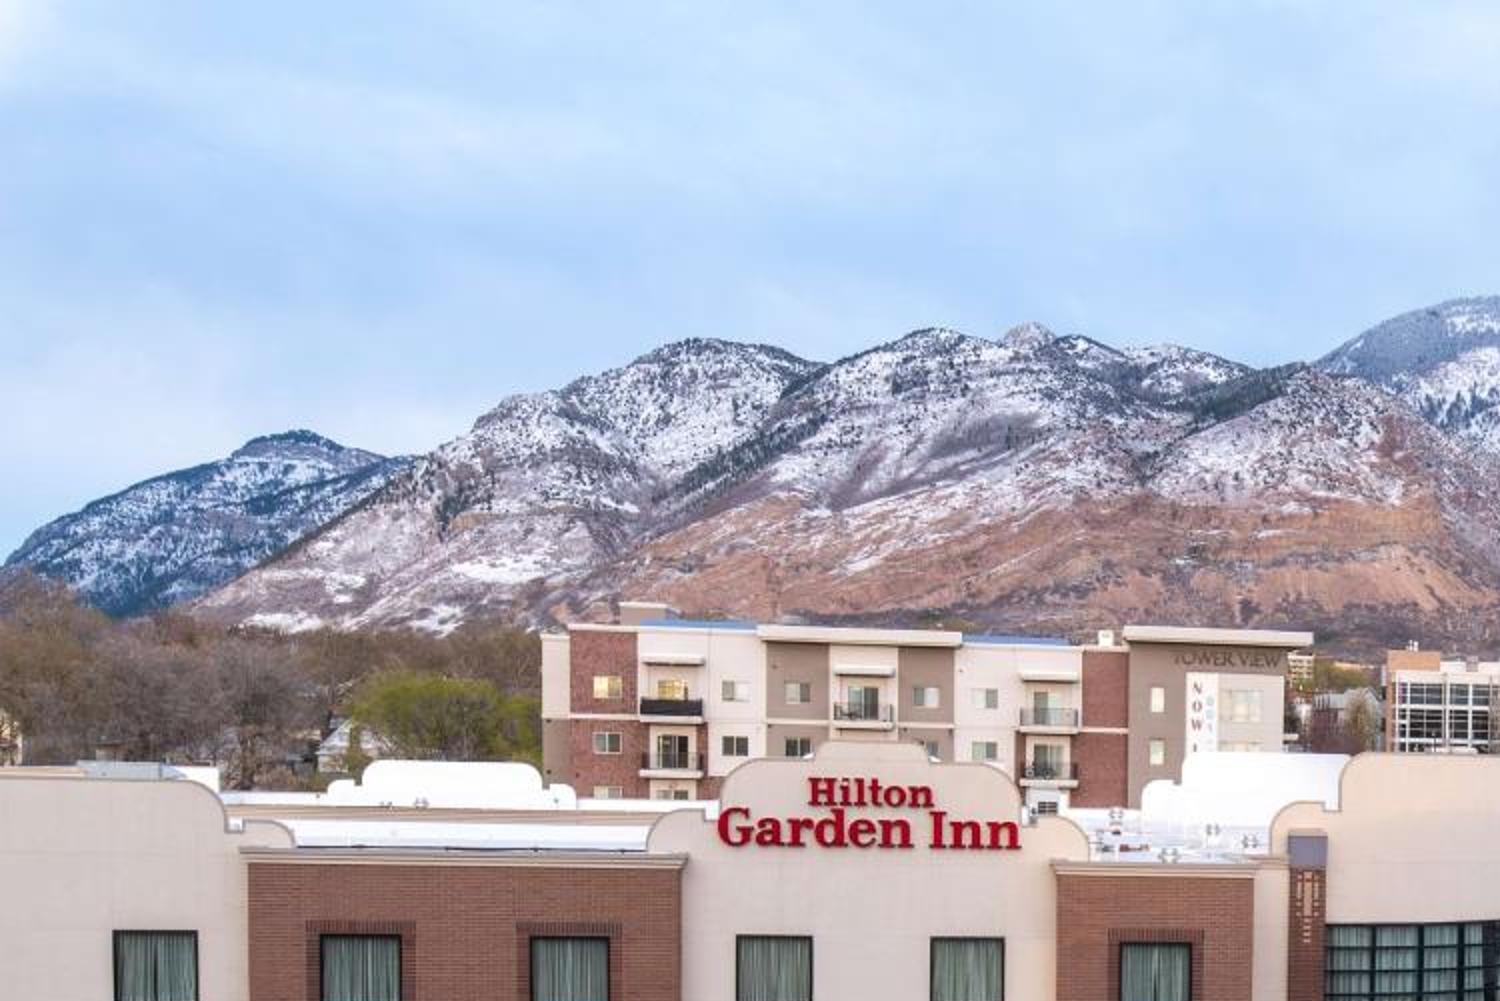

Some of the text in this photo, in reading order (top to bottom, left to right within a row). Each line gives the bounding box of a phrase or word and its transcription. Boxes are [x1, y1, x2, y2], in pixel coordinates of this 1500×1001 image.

[1174, 651, 1280, 669] TOWER VIEW
[808, 777, 936, 808] Hilton
[717, 807, 1022, 850] Garden Inn
